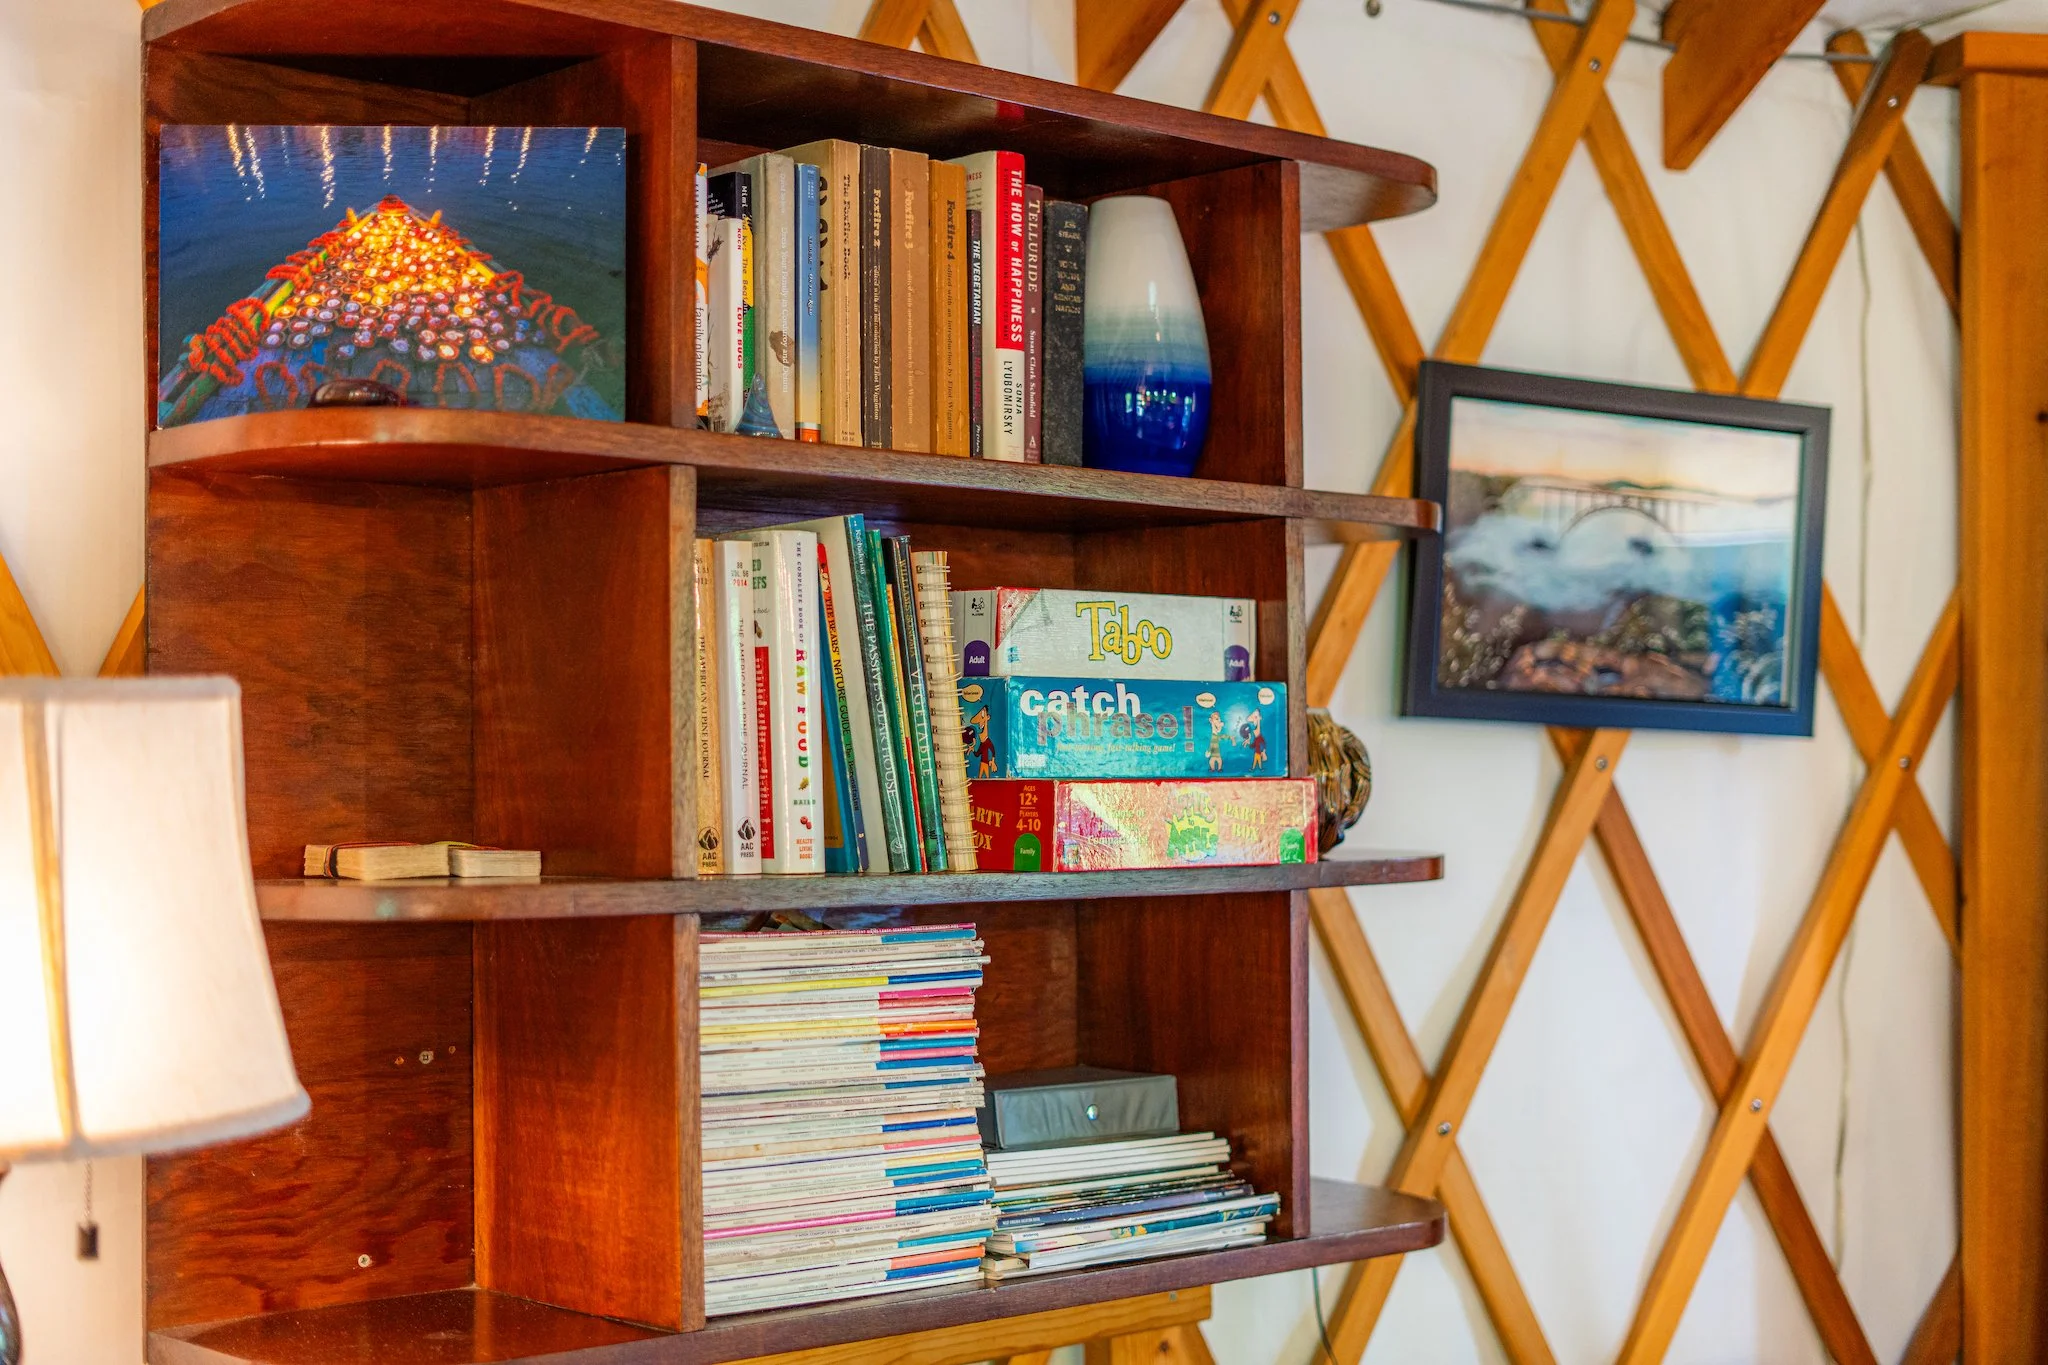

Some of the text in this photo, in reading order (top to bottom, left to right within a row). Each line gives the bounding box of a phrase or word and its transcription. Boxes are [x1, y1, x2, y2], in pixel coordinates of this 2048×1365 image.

[741, 185, 749, 208] Mimi
[872, 188, 881, 249] Foxfire 2
[904, 190, 914, 250] Foxfire 3
[946, 199, 957, 261] Foxfire 4
[781, 251, 789, 270] Your
[1010, 169, 1023, 343] THE HOW OF HAPPINESS
[1027, 199, 1041, 293] TELLURIDE
[780, 271, 789, 298] Family
[873, 265, 881, 286] edited
[946, 263, 955, 288] edited
[973, 239, 983, 325] THE VEGETARIAN
[947, 288, 955, 306] with
[695, 306, 705, 341] family
[779, 309, 790, 348] Corduroy
[782, 349, 790, 364] and
[947, 319, 955, 367] introduction
[874, 366, 882, 383] Eliot
[872, 384, 883, 421] Wigginton
[1003, 360, 1013, 436] LYUBOMIRSKY
[946, 400, 955, 441] Wigginton
[733, 579, 749, 587] 2014
[898, 559, 912, 612] WILLIAMS
[824, 597, 833, 618] THE
[827, 620, 840, 656] BEARS'
[1076, 601, 1173, 665] Taboo
[700, 654, 708, 701] AMERICAN
[739, 642, 748, 697] AMERICAN
[796, 648, 809, 695] RAW
[853, 529, 896, 798] Kachadorian THE PASSIVE SOLAR HOUSE
[968, 655, 986, 664] Adult
[832, 658, 847, 703] NATURE
[1019, 682, 1141, 718] catch
[797, 706, 810, 768] FOOD
[838, 704, 851, 736] GUIDE
[910, 669, 932, 777] VEGETABLE
[1037, 702, 1194, 753] phrase!
[702, 739, 710, 781] JOURNAL
[741, 741, 750, 790] JOURNAL
[1019, 793, 1038, 806] 12+
[1019, 810, 1039, 818] PLAYERS
[1223, 802, 1268, 825] PARTY
[1016, 819, 1041, 832] 4-10
[1231, 823, 1261, 842] BOX
[702, 852, 717, 860] AAC
[740, 842, 754, 850] AAC
[1019, 848, 1036, 857] Family
